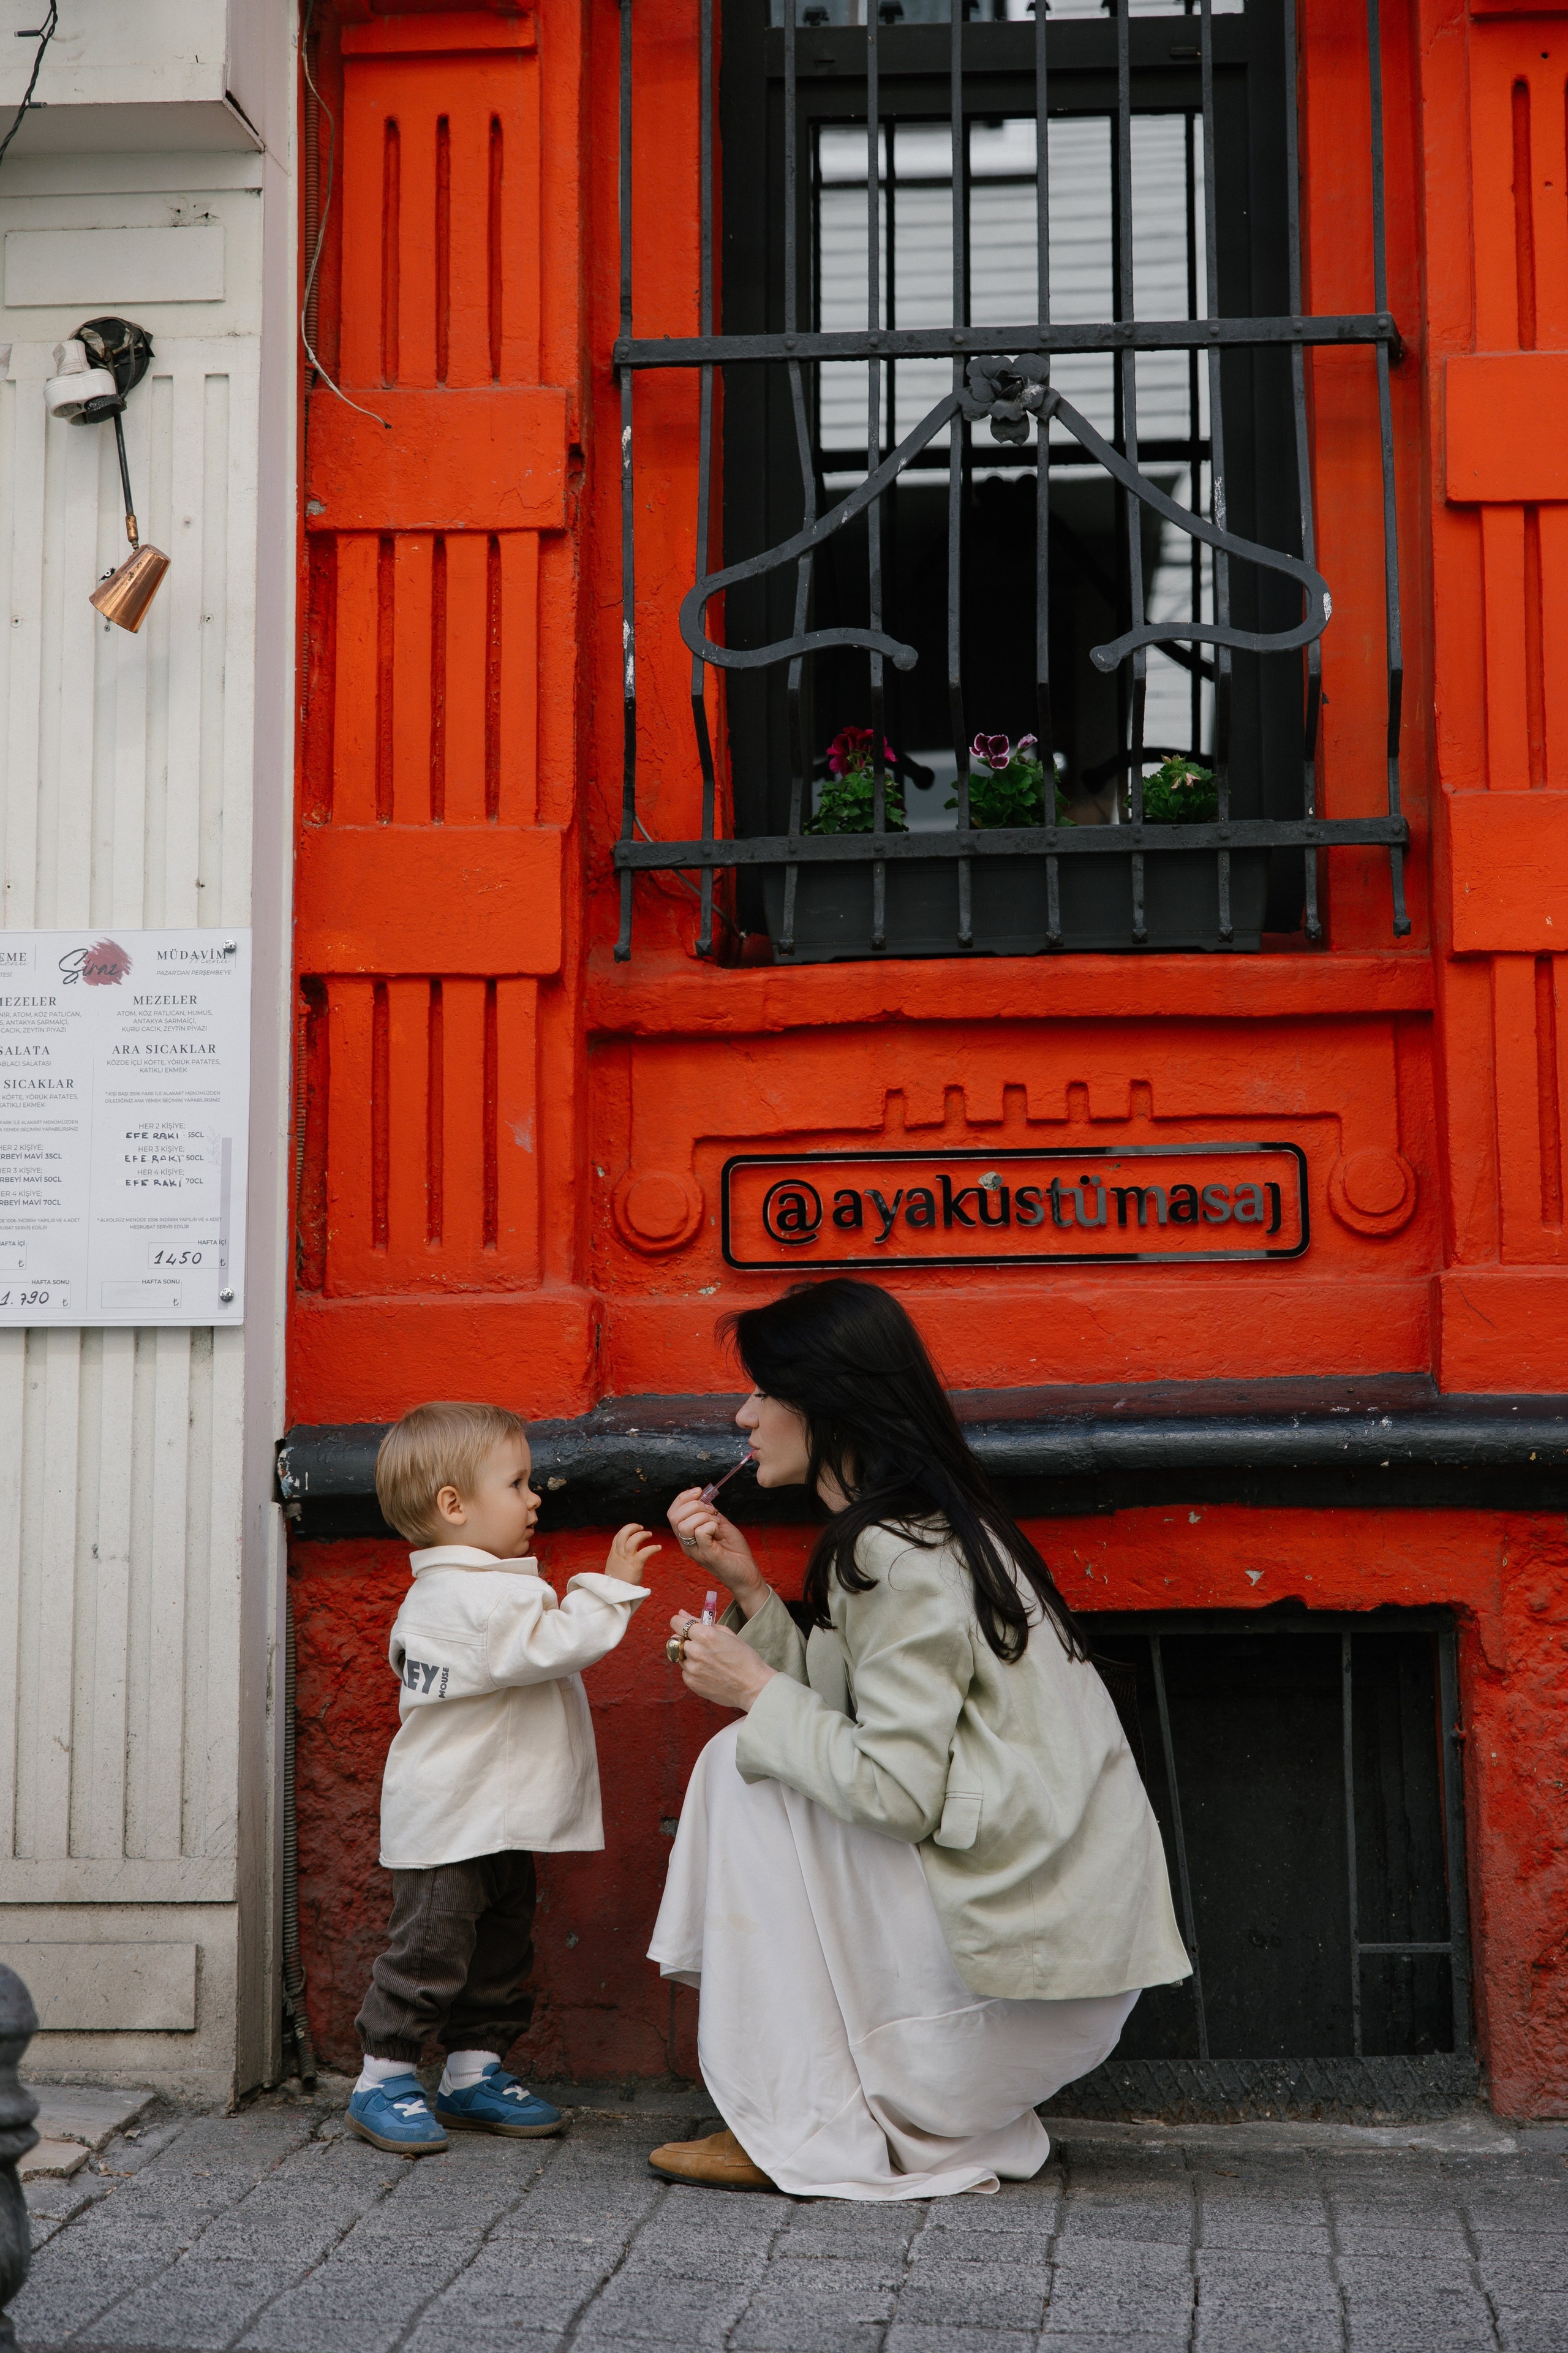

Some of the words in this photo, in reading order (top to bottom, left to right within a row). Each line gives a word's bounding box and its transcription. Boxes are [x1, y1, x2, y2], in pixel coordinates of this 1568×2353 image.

[157, 948, 227, 960] MÜDAVİM
[0, 997, 56, 1007] EZELER
[133, 995, 197, 1005] MEZELER
[111, 1044, 140, 1054] ARA
[145, 1044, 216, 1054] SICAKLAR
[3, 1079, 74, 1089] SICAKLAR
[18, 1189, 42, 1198] KİŞİYE;
[154, 1250, 202, 1266] 1450
[402, 1658, 440, 1695] EY
[438, 1667, 450, 1699] MOUSE
